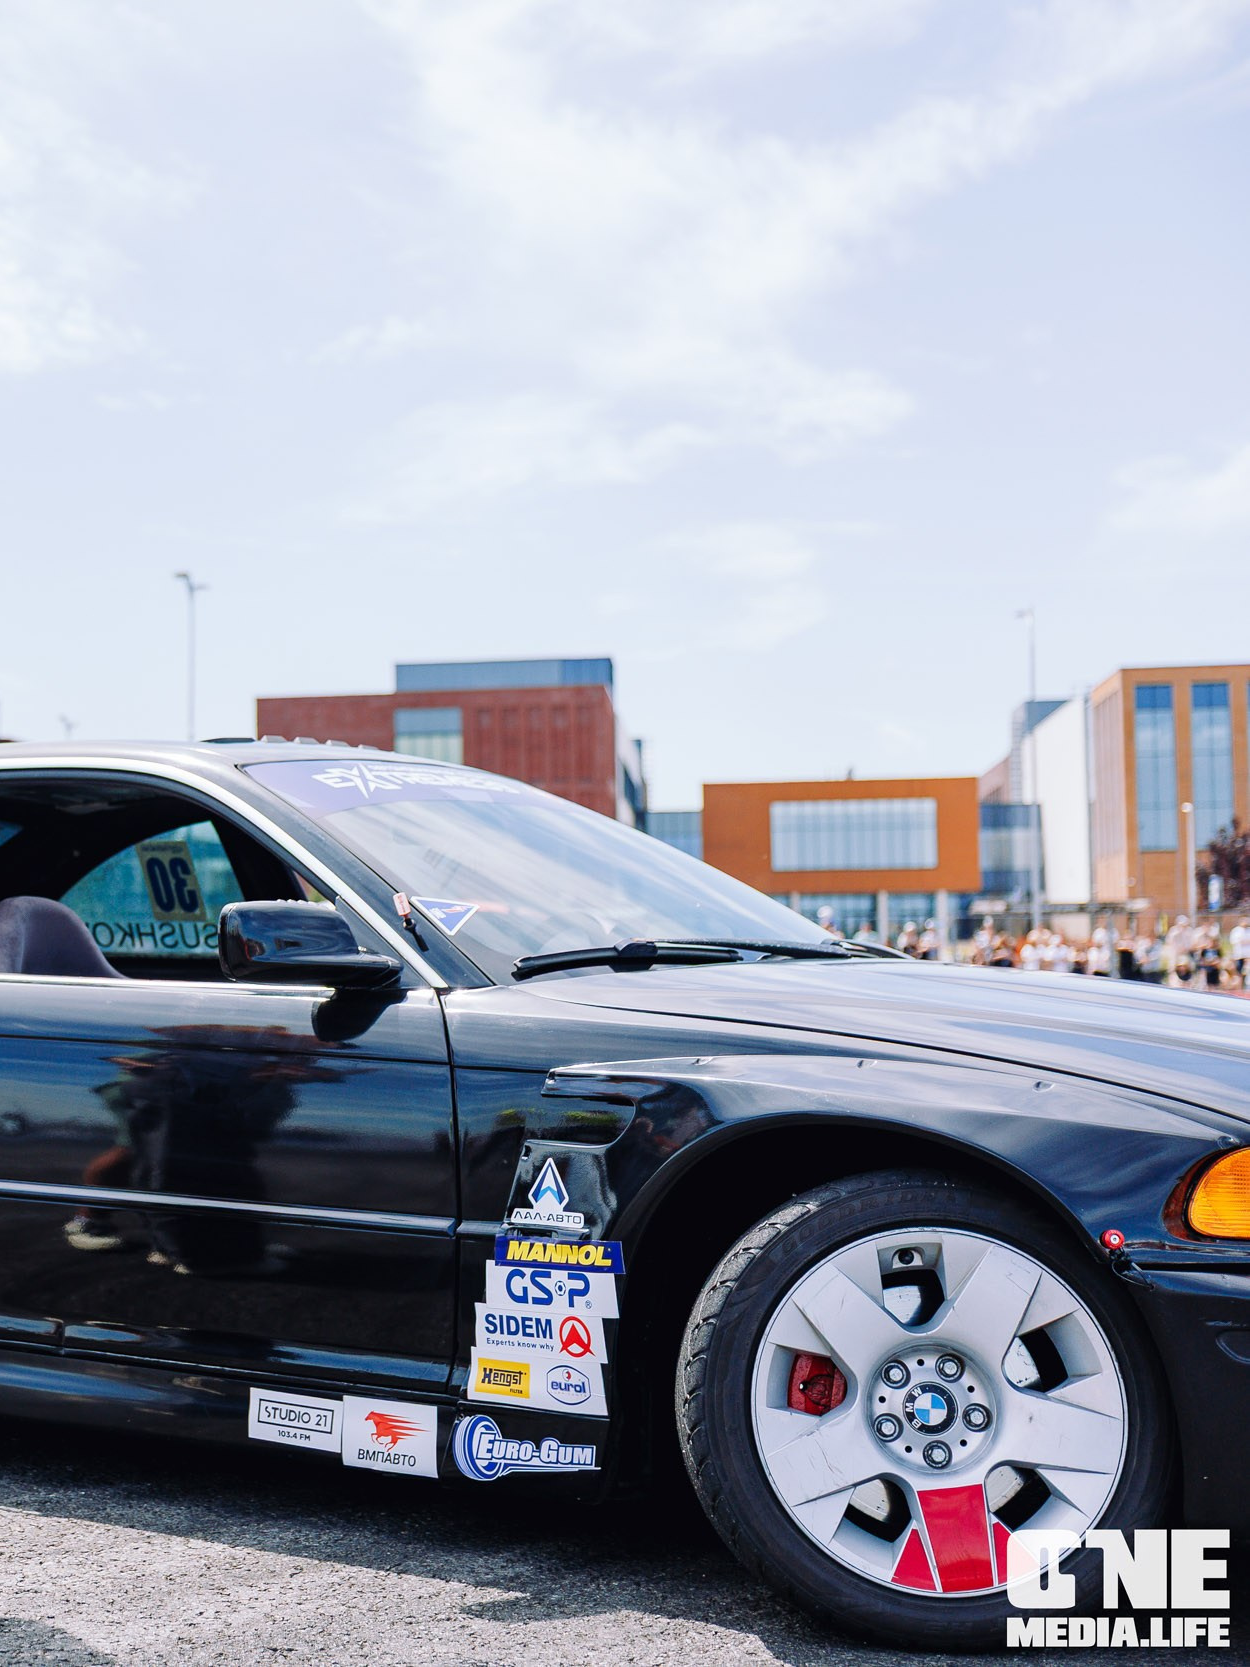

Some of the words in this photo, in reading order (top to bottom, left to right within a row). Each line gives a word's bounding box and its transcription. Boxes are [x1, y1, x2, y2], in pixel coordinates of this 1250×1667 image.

[506, 1239, 612, 1267] MANNOL
[484, 1313, 554, 1340] SIDEM
[486, 1337, 515, 1348] Experts
[517, 1340, 537, 1349] know
[539, 1343, 554, 1352] why
[481, 1367, 523, 1387] Hengst
[551, 1380, 587, 1394] eurol
[264, 1406, 311, 1425] STUDIO
[315, 1414, 328, 1428] 21
[905, 1386, 923, 1429] BMW
[277, 1430, 298, 1440] 103.4
[299, 1433, 311, 1442] FM
[357, 1449, 417, 1467] ВМПАВТО
